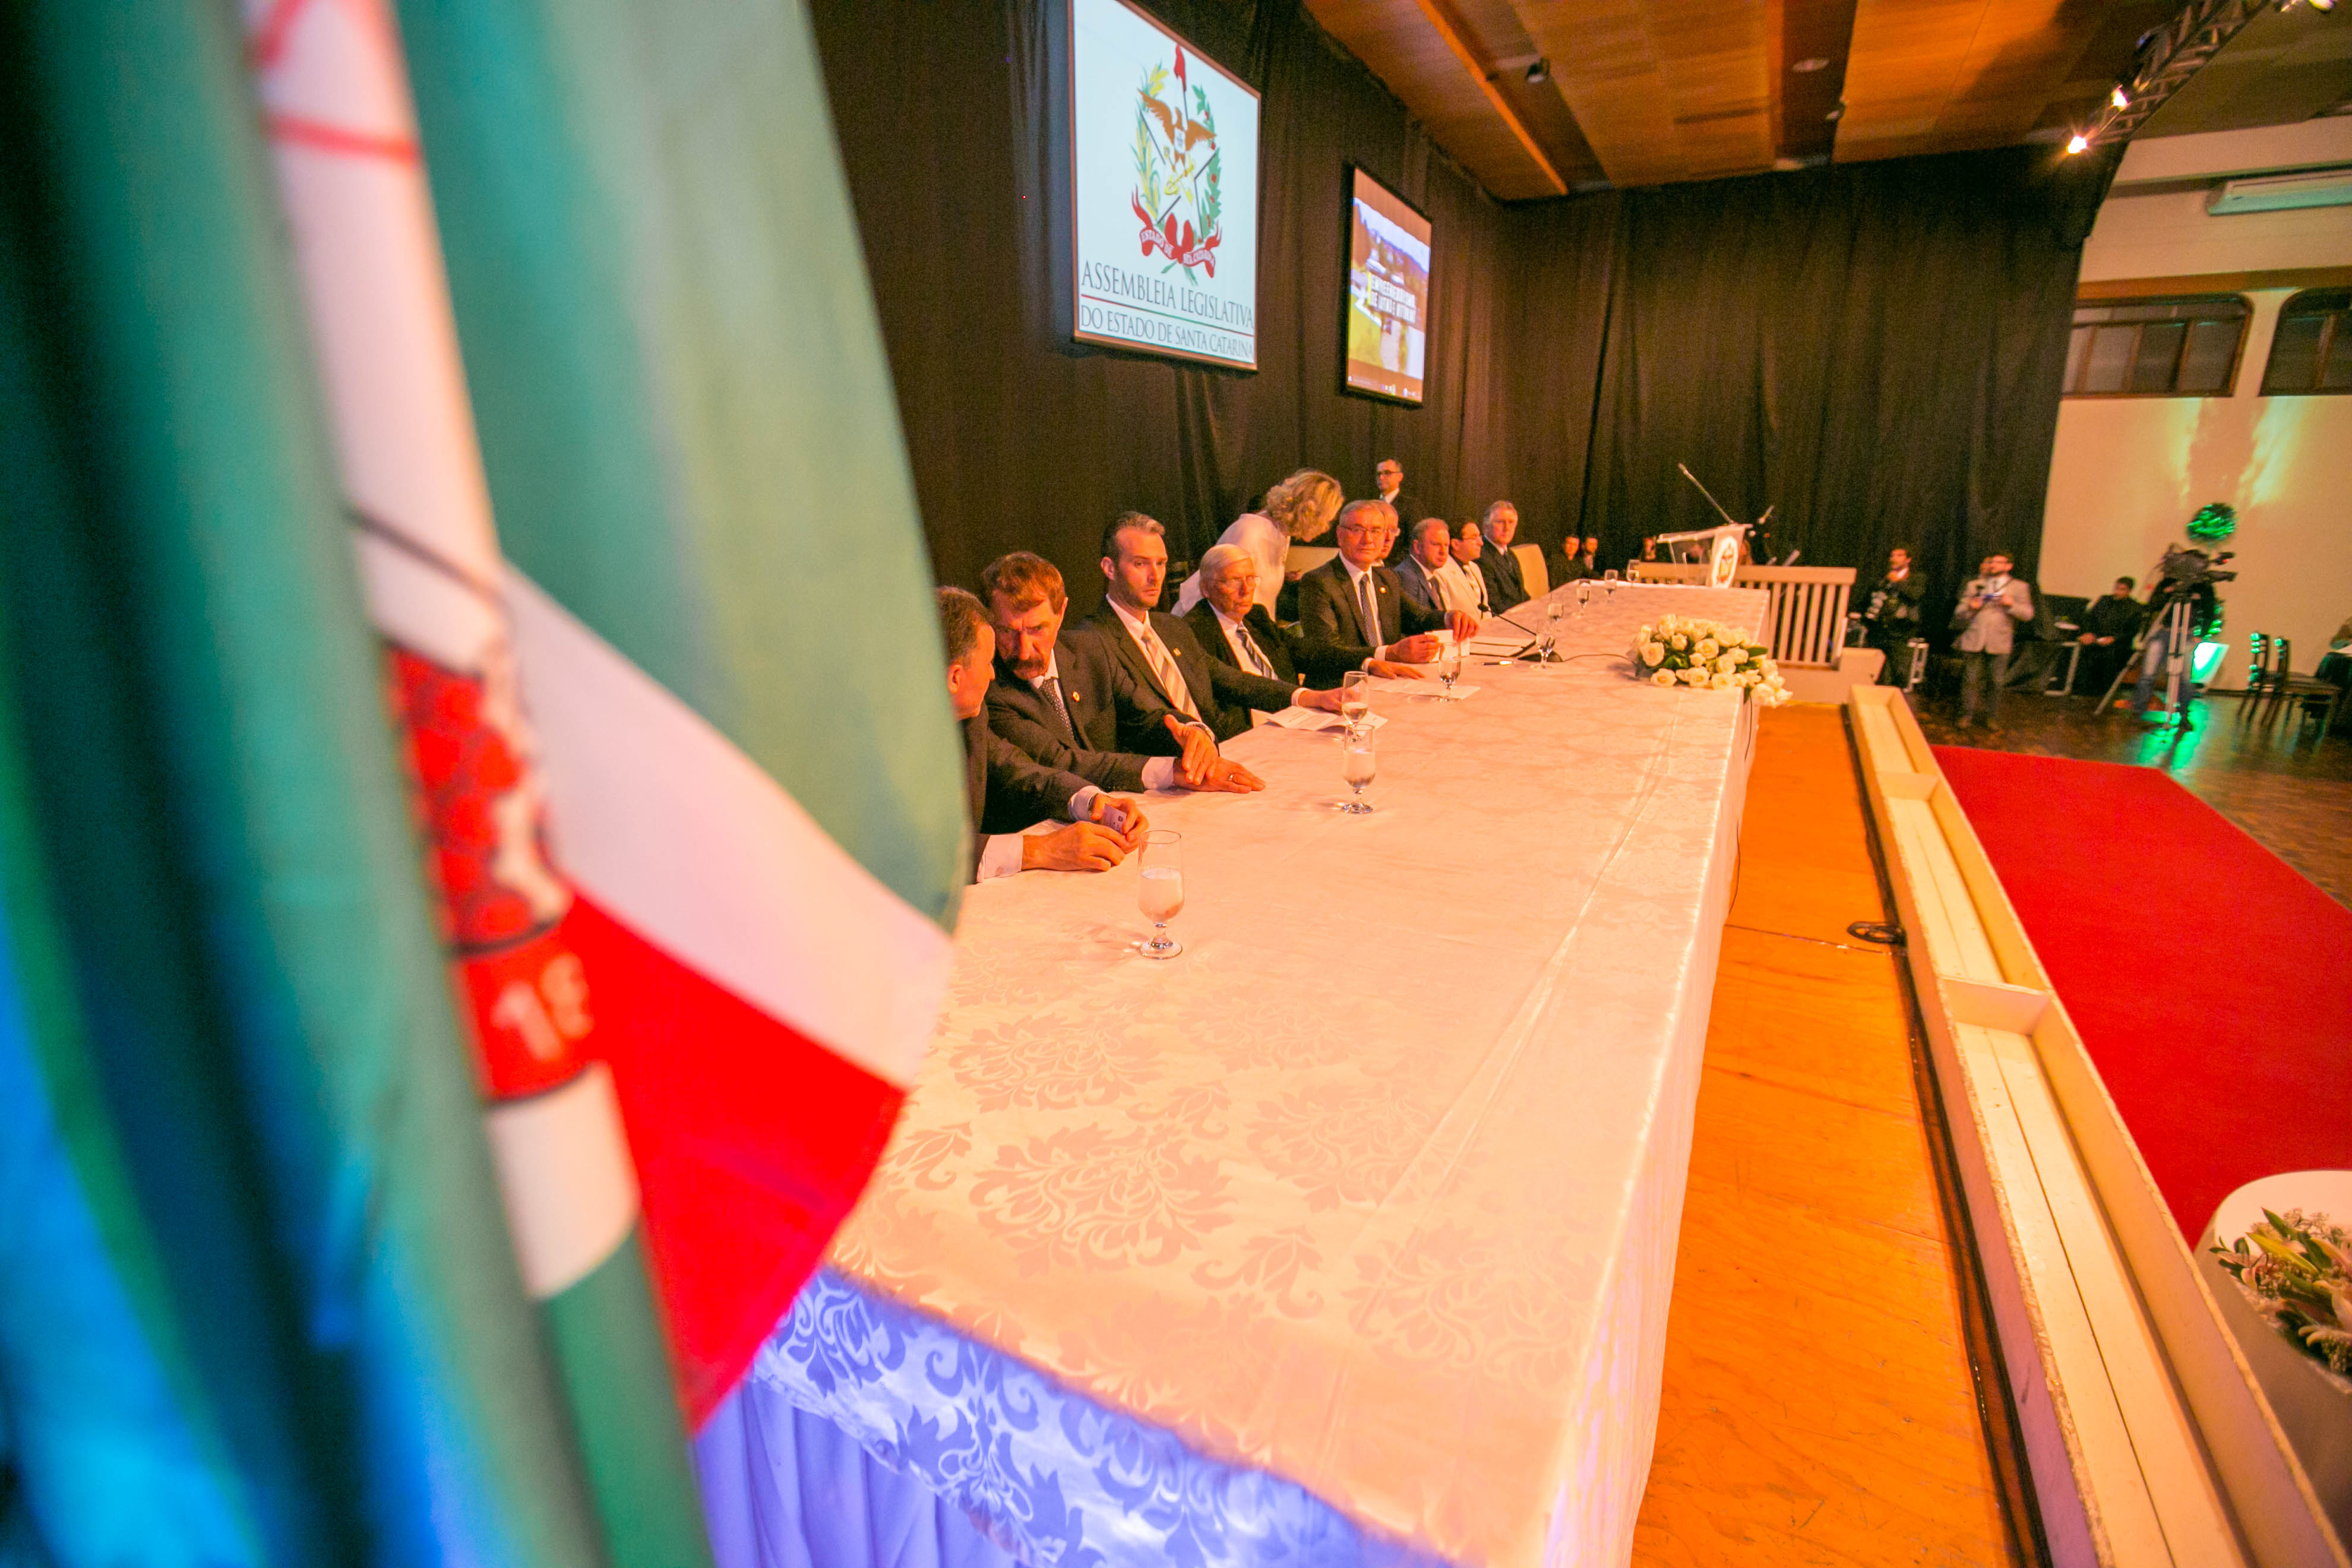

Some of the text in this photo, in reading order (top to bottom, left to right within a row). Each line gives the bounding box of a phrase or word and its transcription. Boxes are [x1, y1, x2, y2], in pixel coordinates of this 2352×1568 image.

[1082, 260, 1254, 328] ASSEMBLEIA LEGISLATIVA
[1081, 305, 1253, 359] DO ESTADO DE SANTA CATARINA
